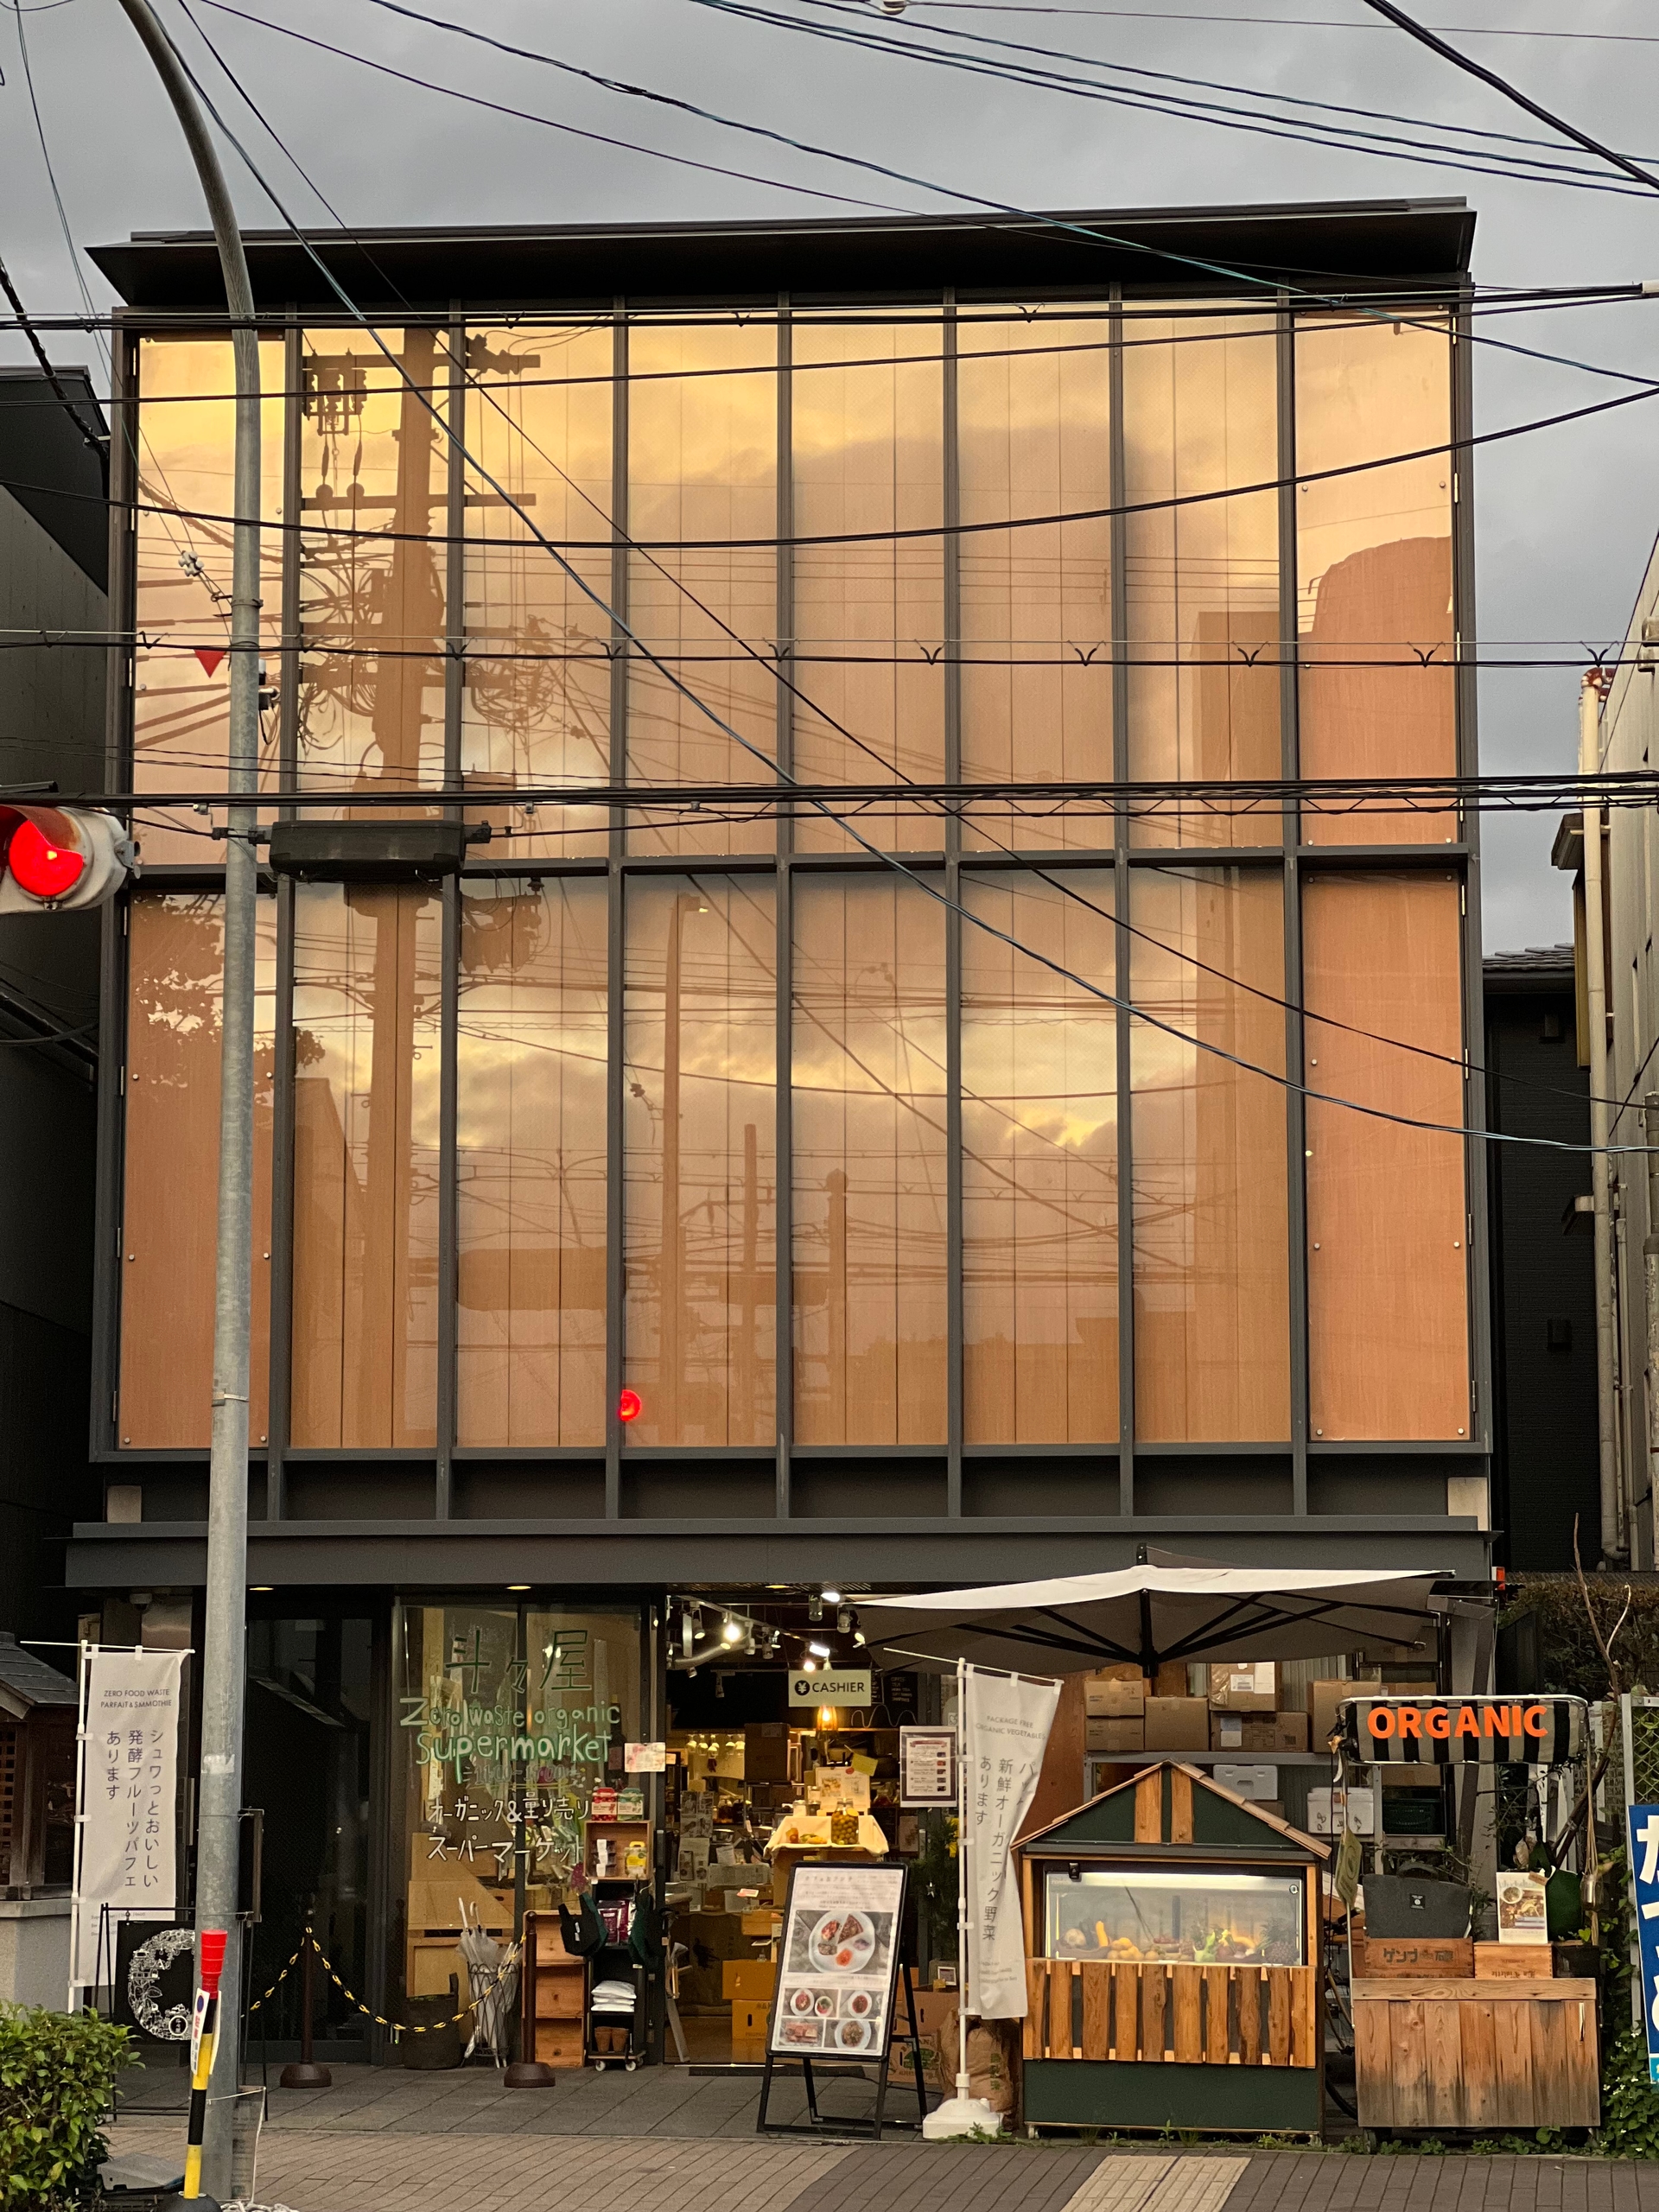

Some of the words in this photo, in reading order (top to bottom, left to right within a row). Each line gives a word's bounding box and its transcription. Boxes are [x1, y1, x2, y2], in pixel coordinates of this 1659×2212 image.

[812, 1681, 865, 1693] CASHIER
[399, 1697, 461, 1726] Zero
[468, 1702, 525, 1727] waste
[533, 1700, 621, 1730] organic
[987, 1715, 1019, 1726] PACKAGE
[1019, 1719, 1033, 1728] FREE
[1366, 1705, 1549, 1739] ORGANIC
[976, 1722, 1006, 1734] ORGANIC
[1007, 1728, 1046, 1740] VEGETABLES
[105, 1731, 121, 1800] あります
[124, 1729, 143, 1887] 発酵フルーツパフェ
[143, 1729, 164, 1887] シュワっとおいしい
[975, 1756, 992, 1826] あります
[426, 1834, 586, 1864] スーパーマーケット
[982, 1758, 1014, 1941] 新鮮オーガニック野菜
